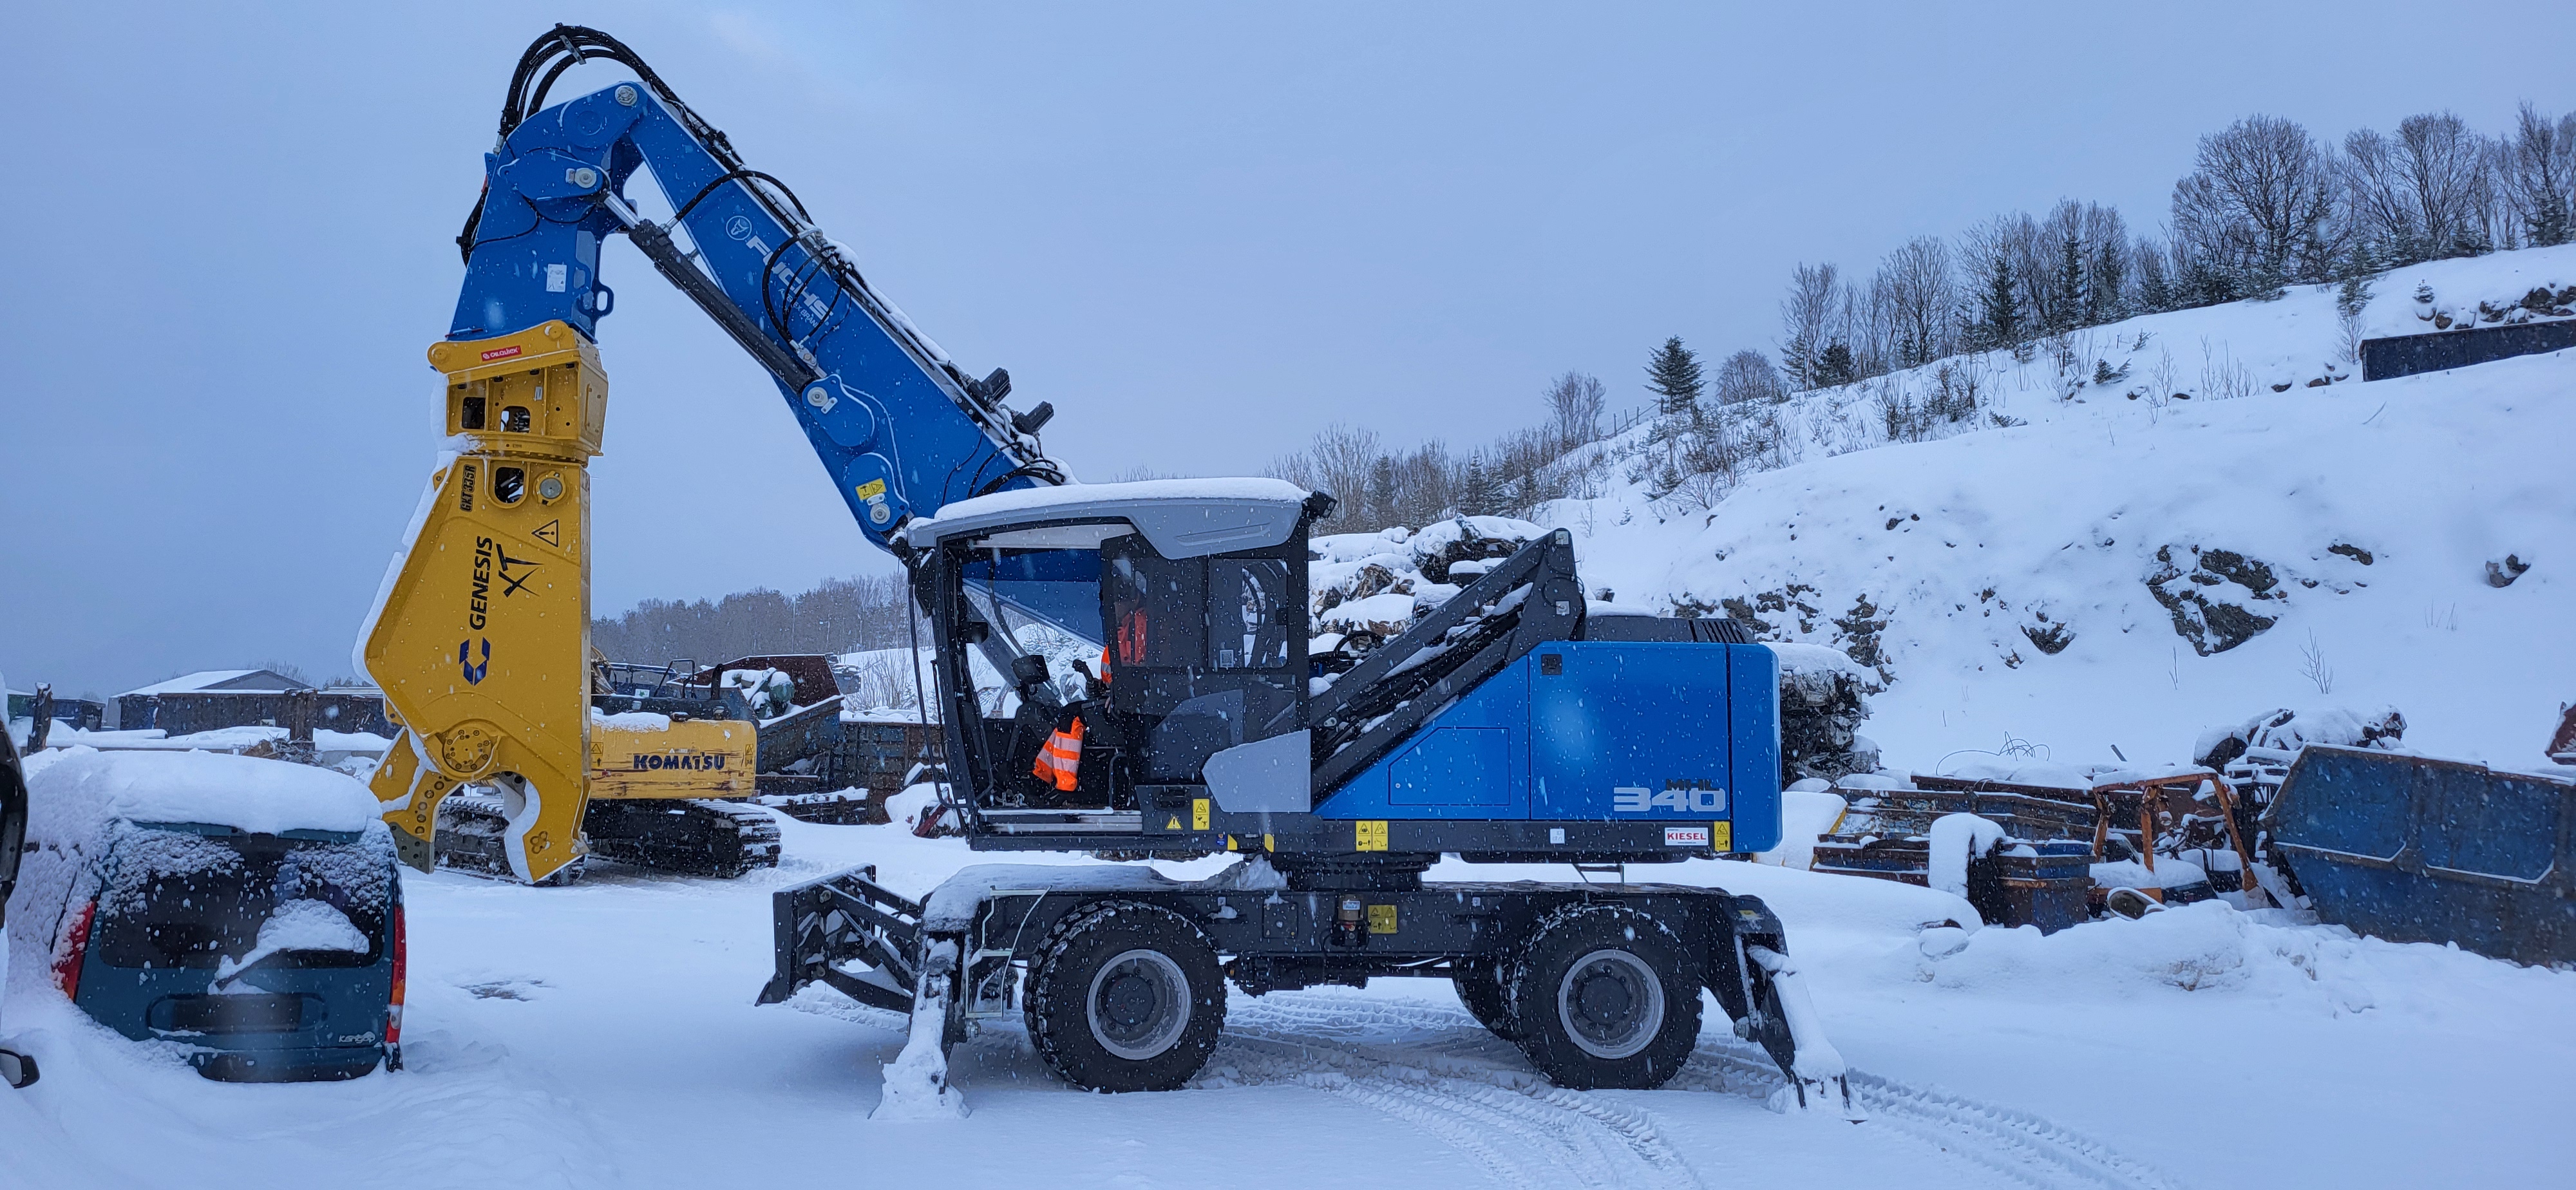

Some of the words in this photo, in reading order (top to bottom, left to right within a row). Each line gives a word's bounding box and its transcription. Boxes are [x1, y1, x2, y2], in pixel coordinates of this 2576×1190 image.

[800, 309, 820, 328] BRAN
[496, 543, 545, 598] XT
[469, 536, 493, 630] GENESIS
[633, 754, 725, 770] KOMATSU
[1665, 779, 1719, 791] MHL
[1613, 787, 1726, 812] 340
